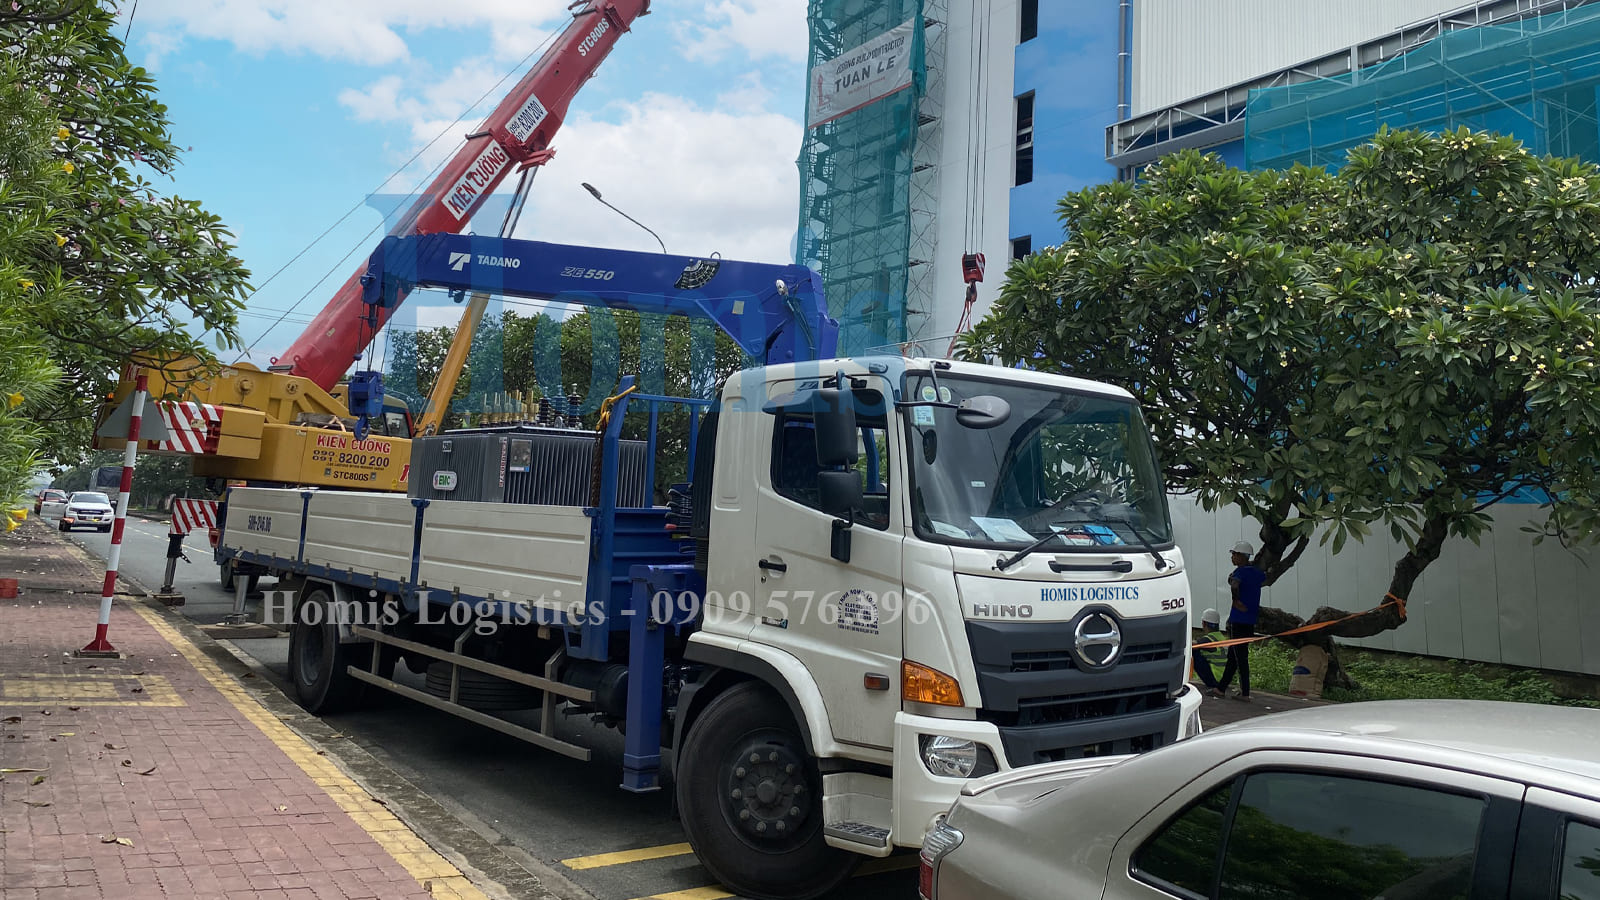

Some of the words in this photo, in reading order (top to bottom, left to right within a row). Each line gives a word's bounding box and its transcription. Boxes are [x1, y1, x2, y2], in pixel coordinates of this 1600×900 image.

[577, 18, 610, 56] STC800S
[477, 254, 521, 268] TADANO
[339, 452, 367, 465] 8200
[369, 456, 390, 467] 200
[333, 470, 369, 482] STC800S
[1040, 587, 1078, 602] HOMIS
[1079, 586, 1140, 601] LOGISTICS
[973, 603, 1033, 618] HINO
[1160, 597, 1186, 611] 500
